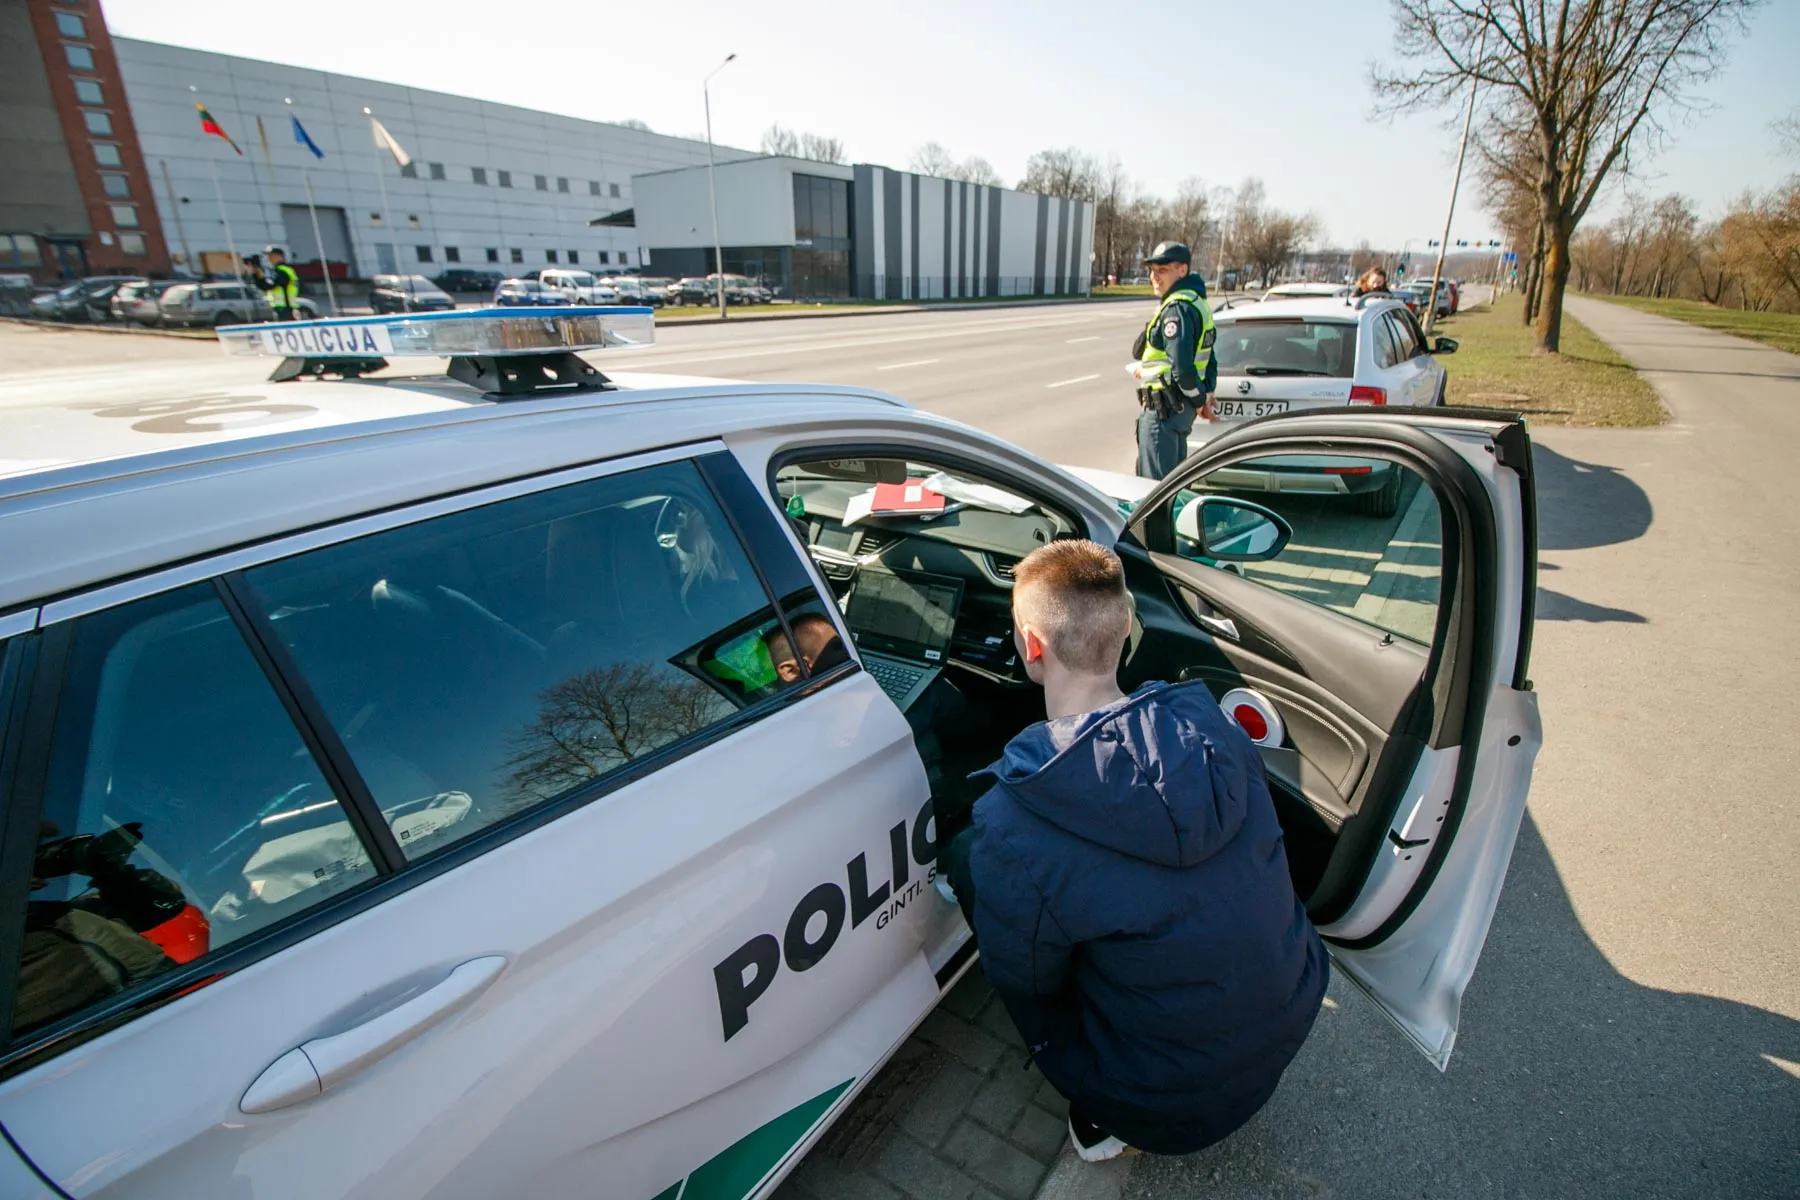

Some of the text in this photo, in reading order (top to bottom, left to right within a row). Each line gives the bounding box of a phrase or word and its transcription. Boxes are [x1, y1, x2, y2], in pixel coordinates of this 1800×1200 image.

[271, 325, 379, 353] POLICIJA
[1213, 401, 1284, 417] JBA 571
[713, 797, 937, 1043] POLIC
[876, 880, 923, 930] GINTI.
